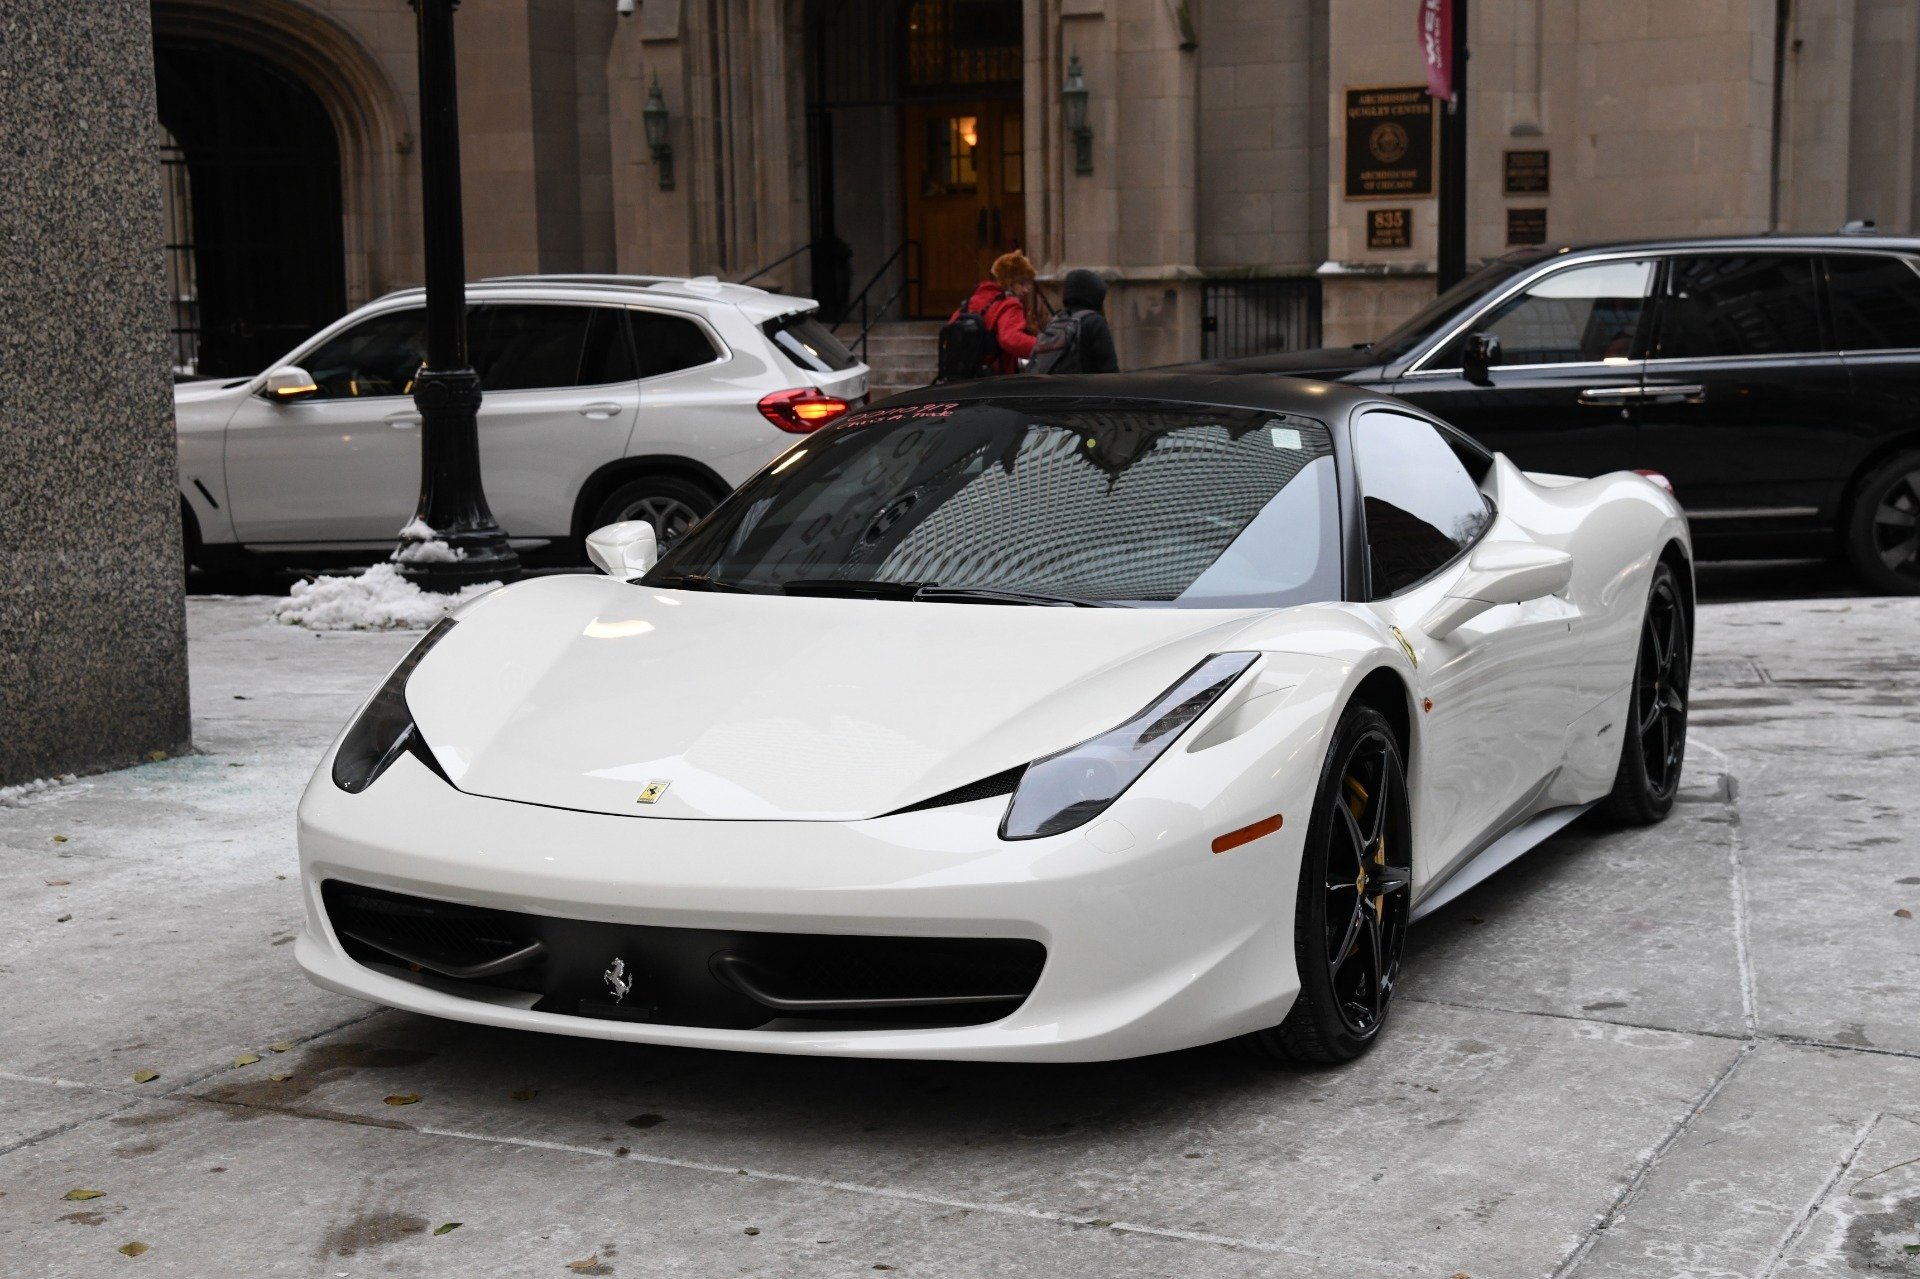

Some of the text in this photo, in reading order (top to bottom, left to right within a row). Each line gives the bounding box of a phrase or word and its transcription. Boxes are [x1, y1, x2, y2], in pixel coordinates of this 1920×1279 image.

[1359, 93, 1420, 105] ARCHBISHOP
[1348, 103, 1430, 119] QUIGLEY CENTER
[1363, 180, 1414, 190] OF CHICAGO
[1375, 211, 1404, 228] 835
